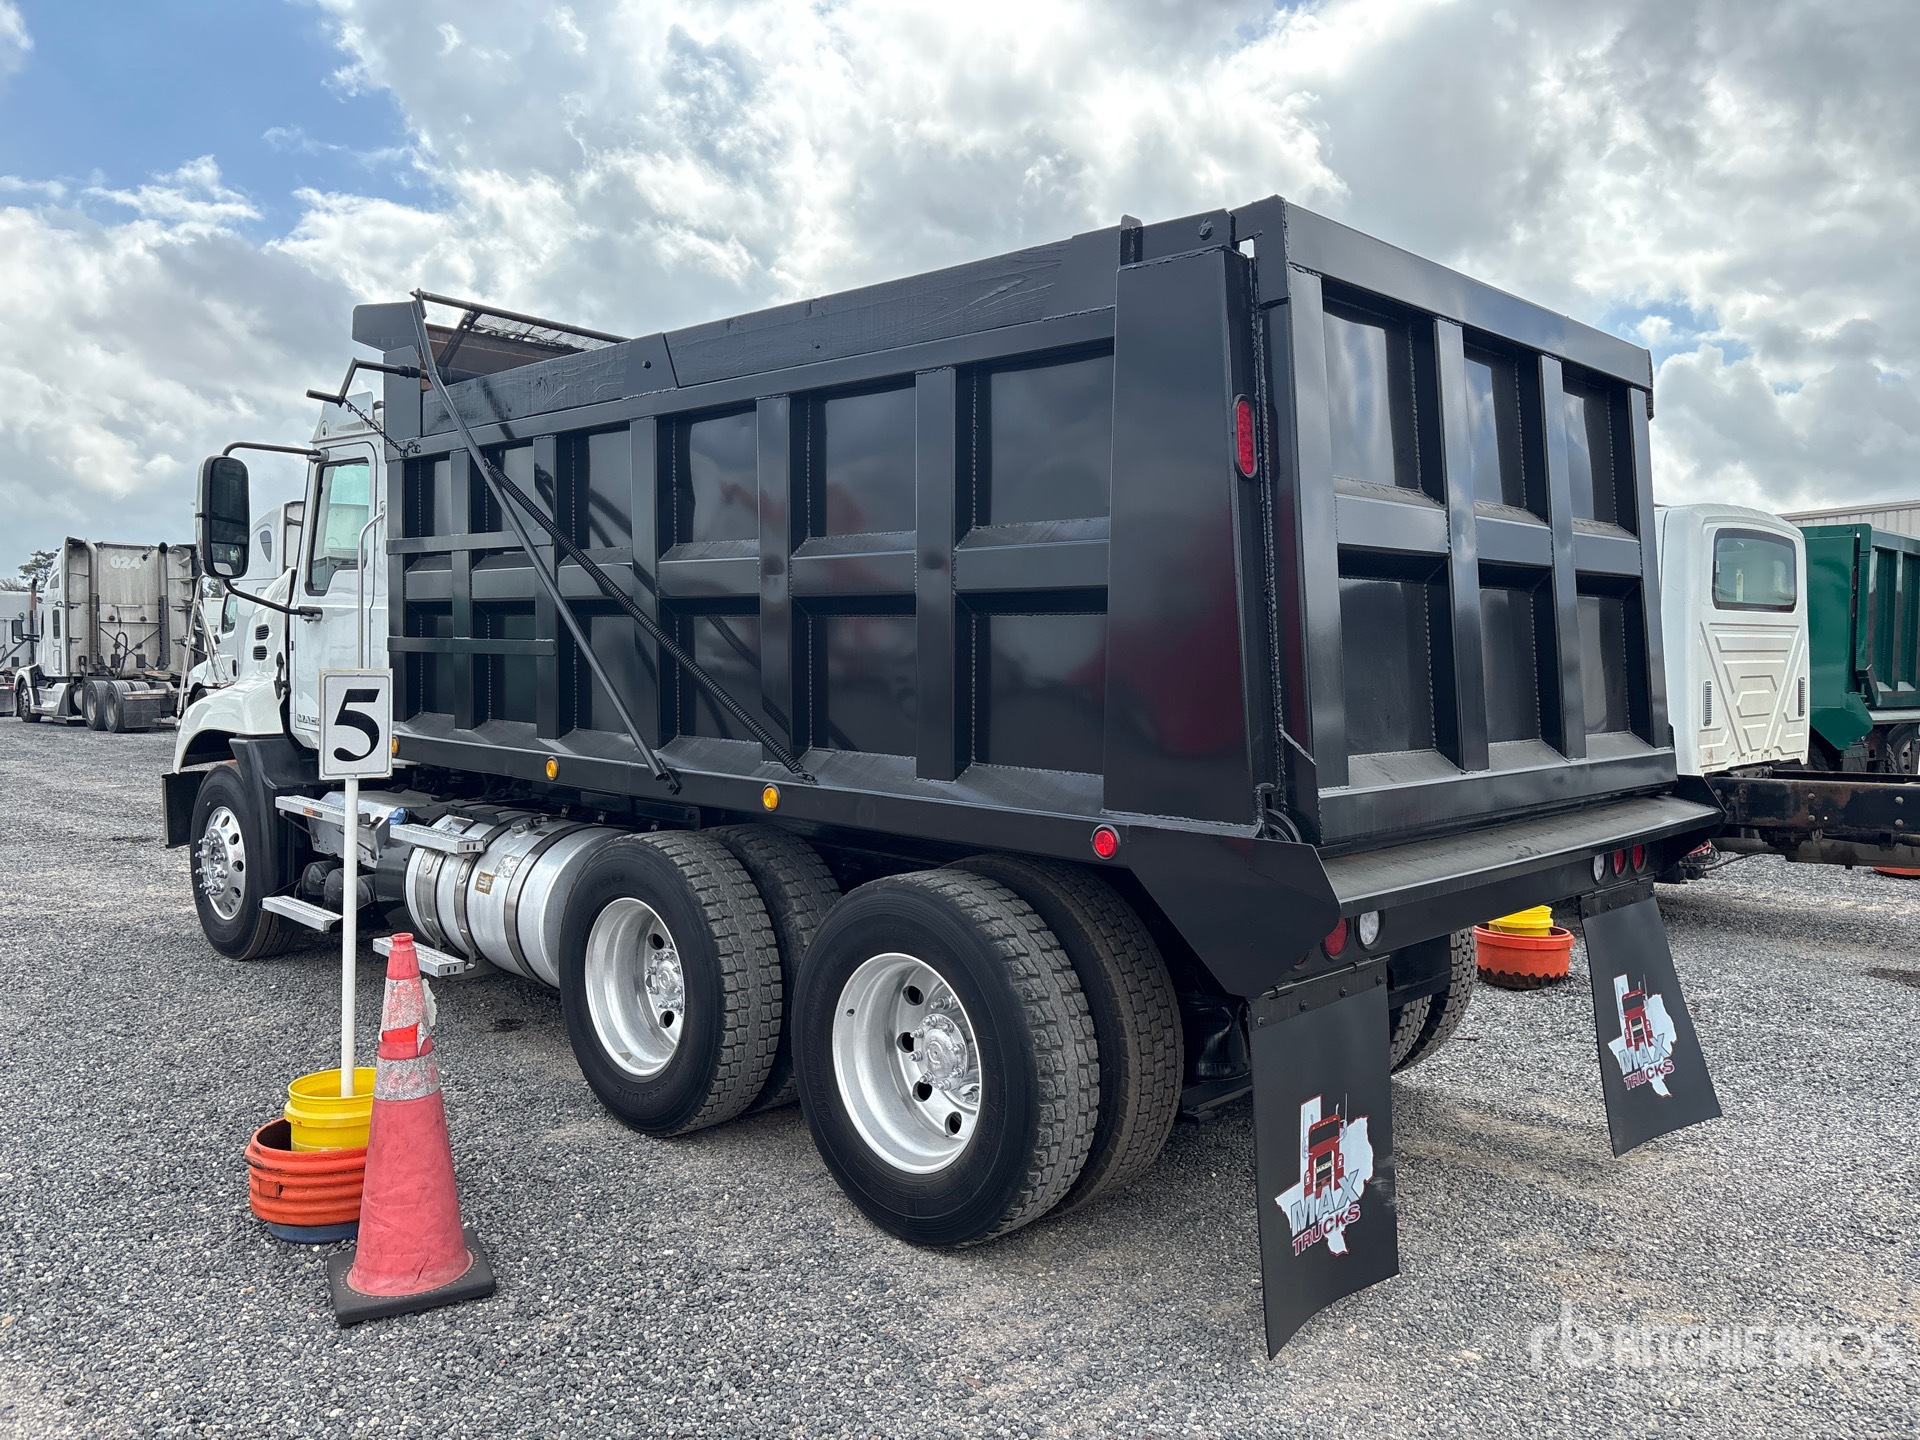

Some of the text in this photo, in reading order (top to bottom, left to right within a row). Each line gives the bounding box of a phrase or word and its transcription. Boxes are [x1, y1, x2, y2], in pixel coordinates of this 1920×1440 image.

[110, 555, 141, 570] 024
[333, 689, 380, 762] 5
[1618, 1033, 1672, 1076] MAX
[1623, 1058, 1675, 1091] TRUCKS
[1290, 1169, 1361, 1237] MAX
[1292, 1203, 1361, 1257] TRUCKS
